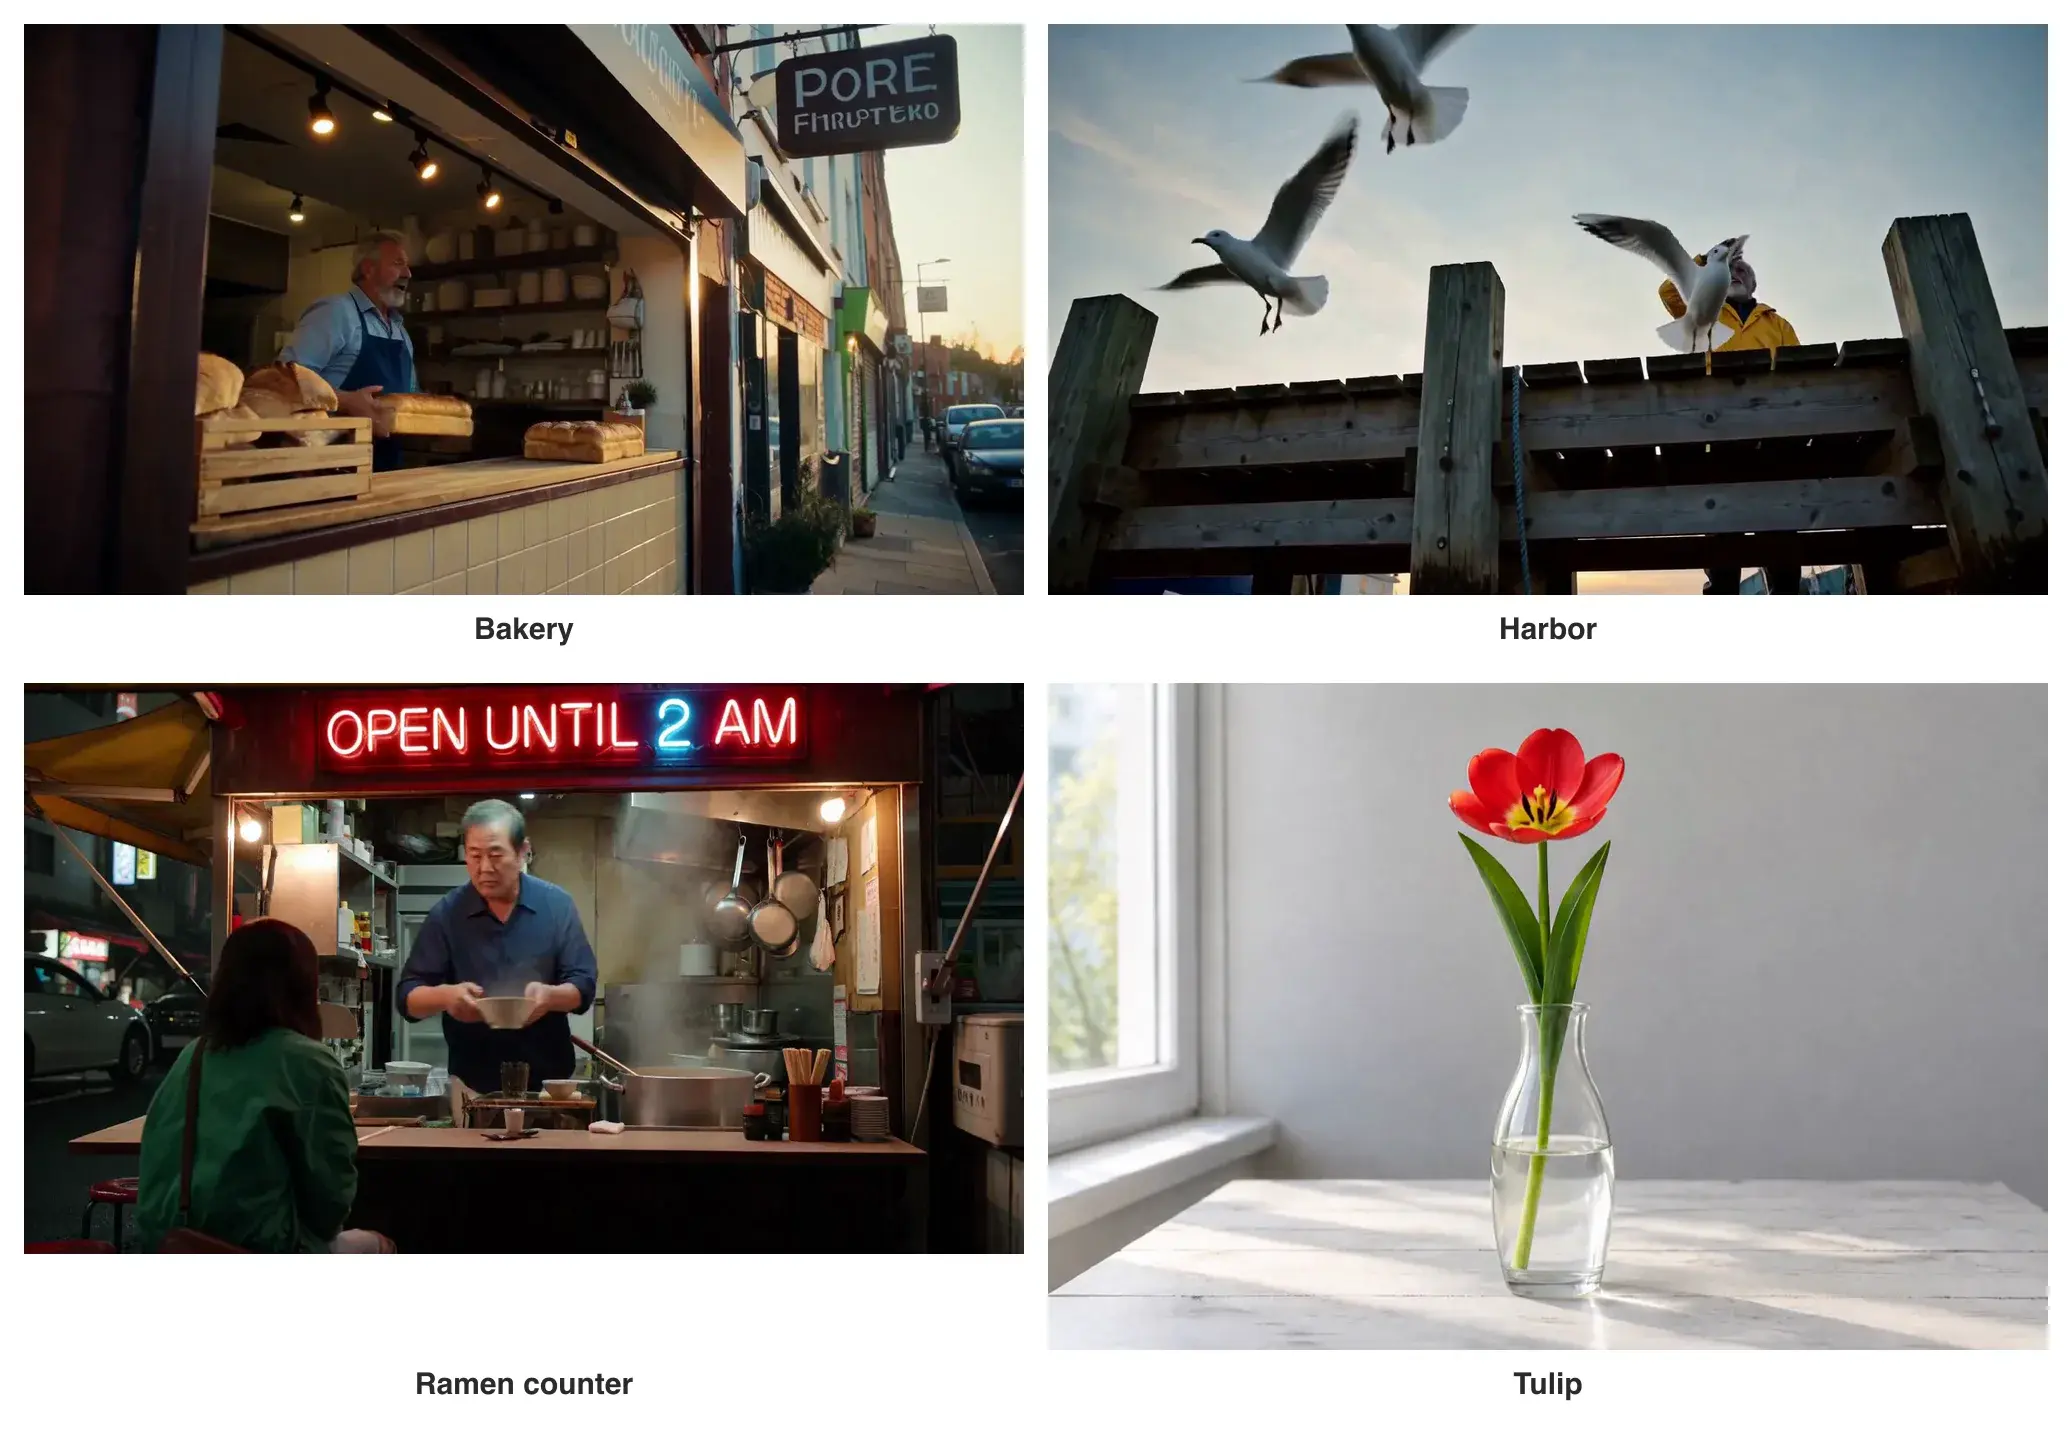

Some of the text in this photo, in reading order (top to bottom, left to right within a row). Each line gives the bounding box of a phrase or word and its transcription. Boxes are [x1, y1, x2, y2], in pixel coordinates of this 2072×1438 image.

[795, 53, 937, 108] PORE
[327, 697, 796, 755] OPEN UNTIL 2 AM
